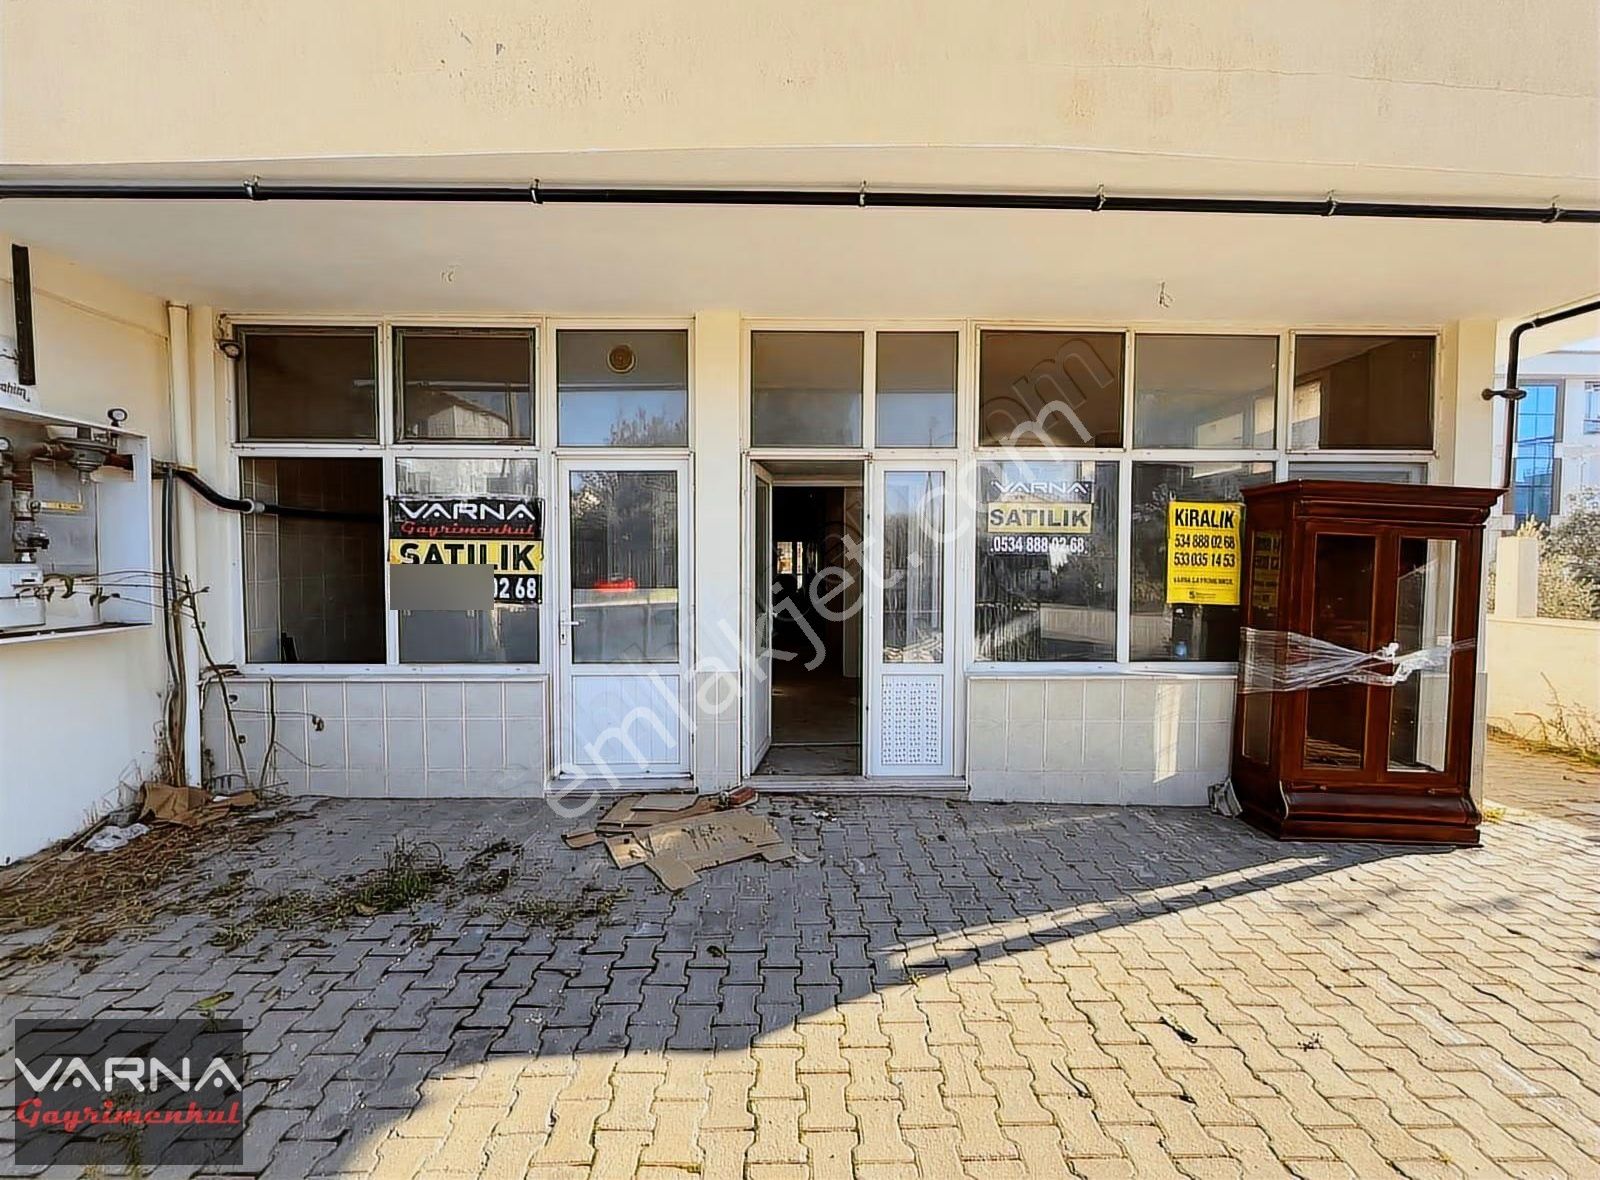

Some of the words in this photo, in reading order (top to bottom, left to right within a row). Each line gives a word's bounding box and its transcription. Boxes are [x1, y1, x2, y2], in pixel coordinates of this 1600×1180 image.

[994, 481, 1088, 494] VARNA
[399, 502, 535, 520] VARNA
[990, 509, 1089, 527] SATILIK
[994, 536, 1022, 552] 0534
[1026, 536, 1048, 553] 888
[1175, 533, 1190, 548] 534
[515, 577, 537, 599] 68
